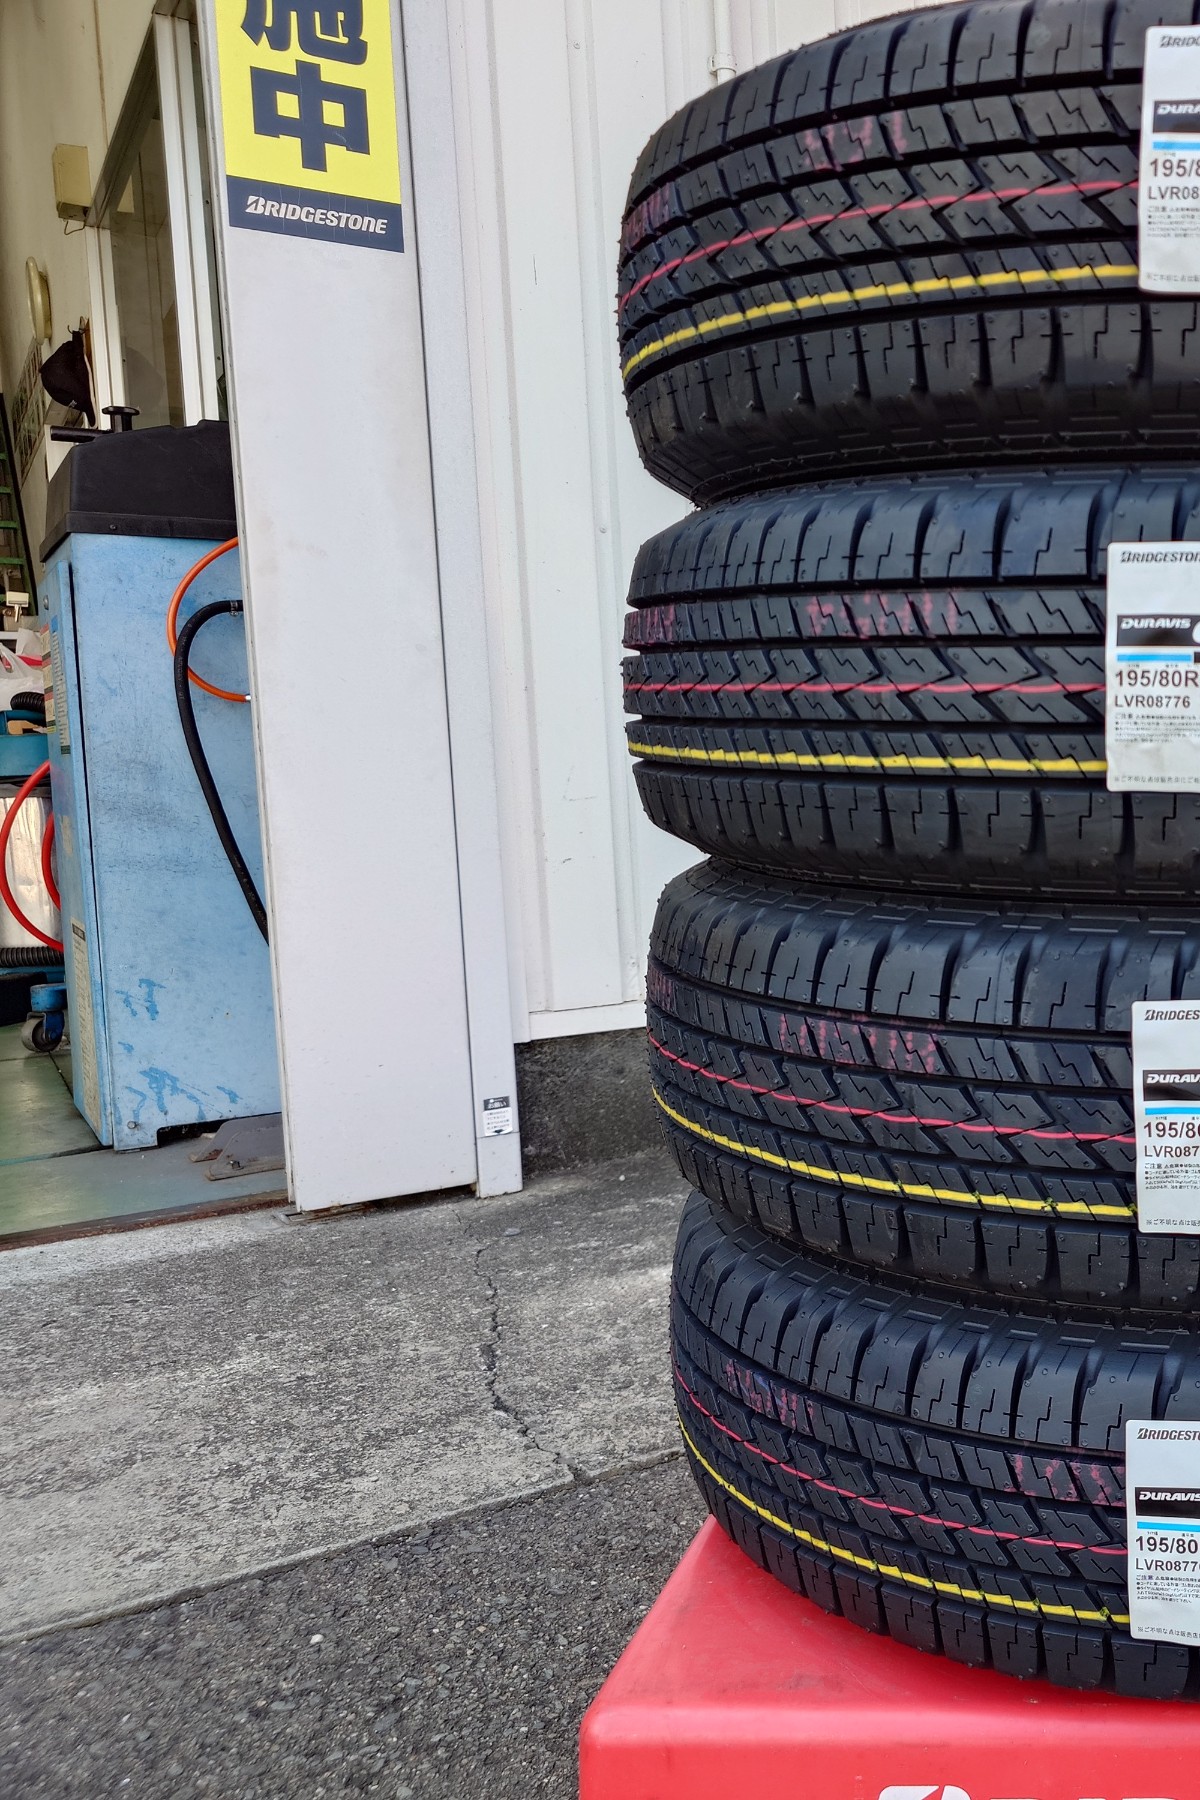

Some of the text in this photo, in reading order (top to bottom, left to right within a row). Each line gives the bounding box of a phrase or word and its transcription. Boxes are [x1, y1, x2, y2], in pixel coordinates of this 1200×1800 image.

[245, 195, 388, 234] BRIDGESTONE
[1121, 618, 1191, 629] DURAVIS
[1115, 695, 1191, 709] LVR08776
